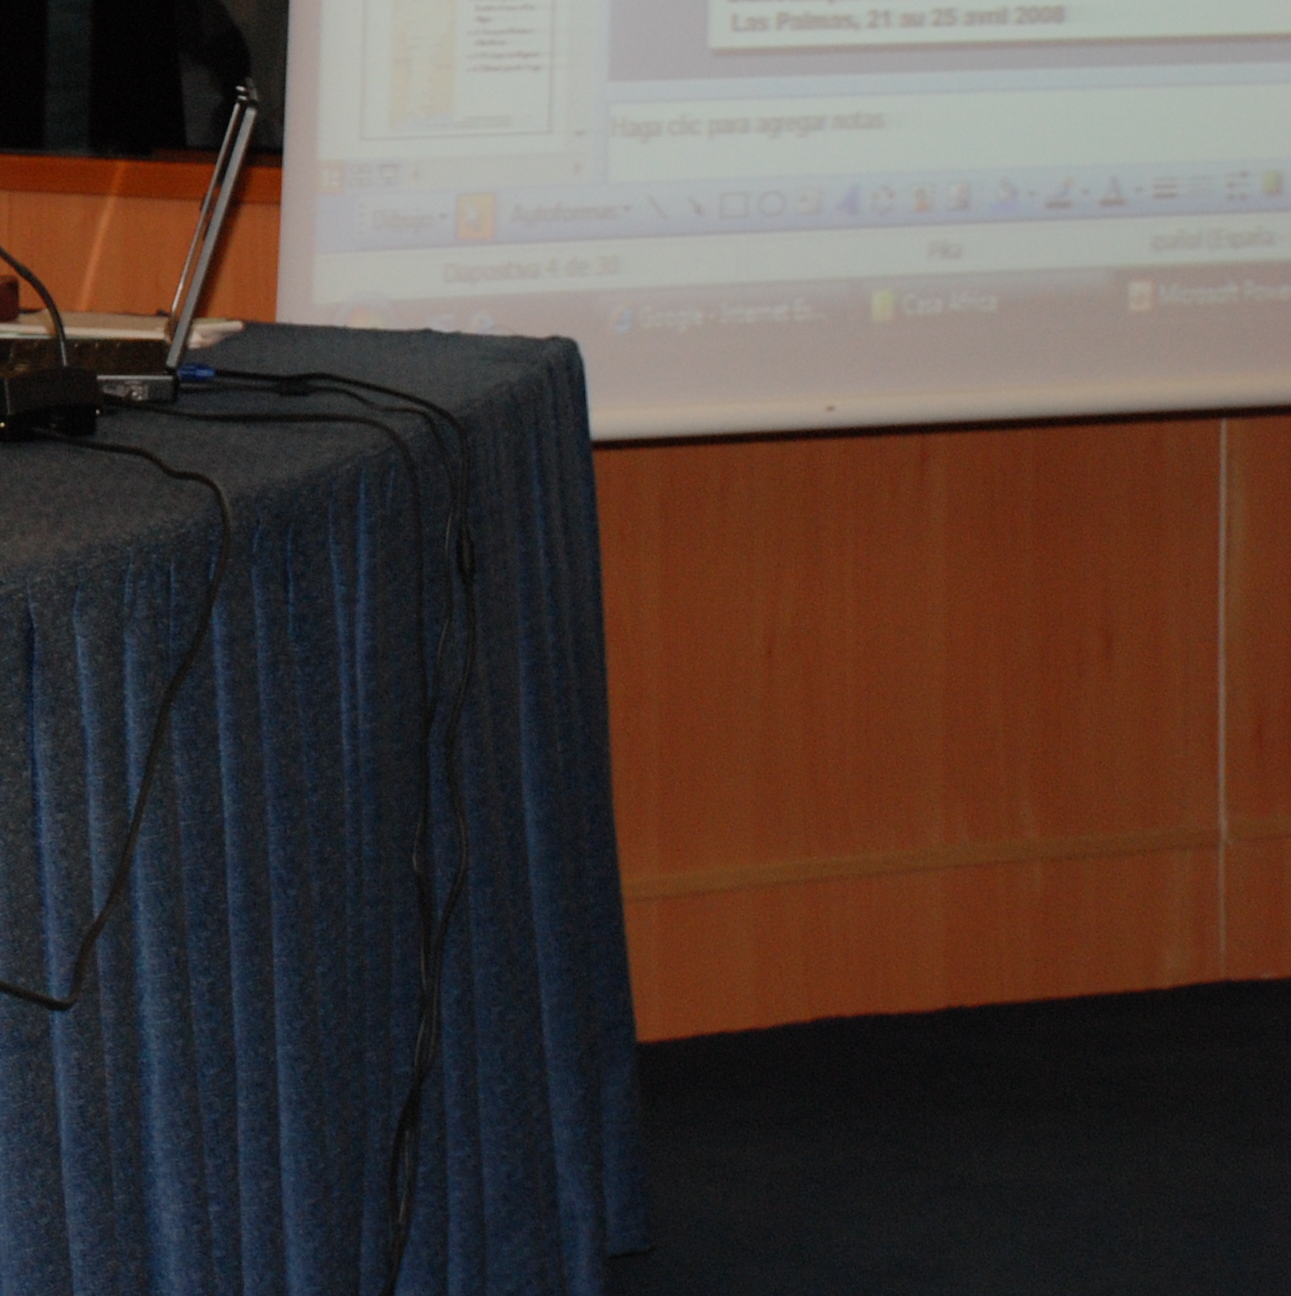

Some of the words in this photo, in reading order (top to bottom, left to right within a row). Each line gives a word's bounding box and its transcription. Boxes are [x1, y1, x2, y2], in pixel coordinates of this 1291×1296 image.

[730, 12, 770, 34] Las
[898, 12, 928, 30] au
[930, 7, 960, 28] 25
[963, 6, 1010, 27] avril
